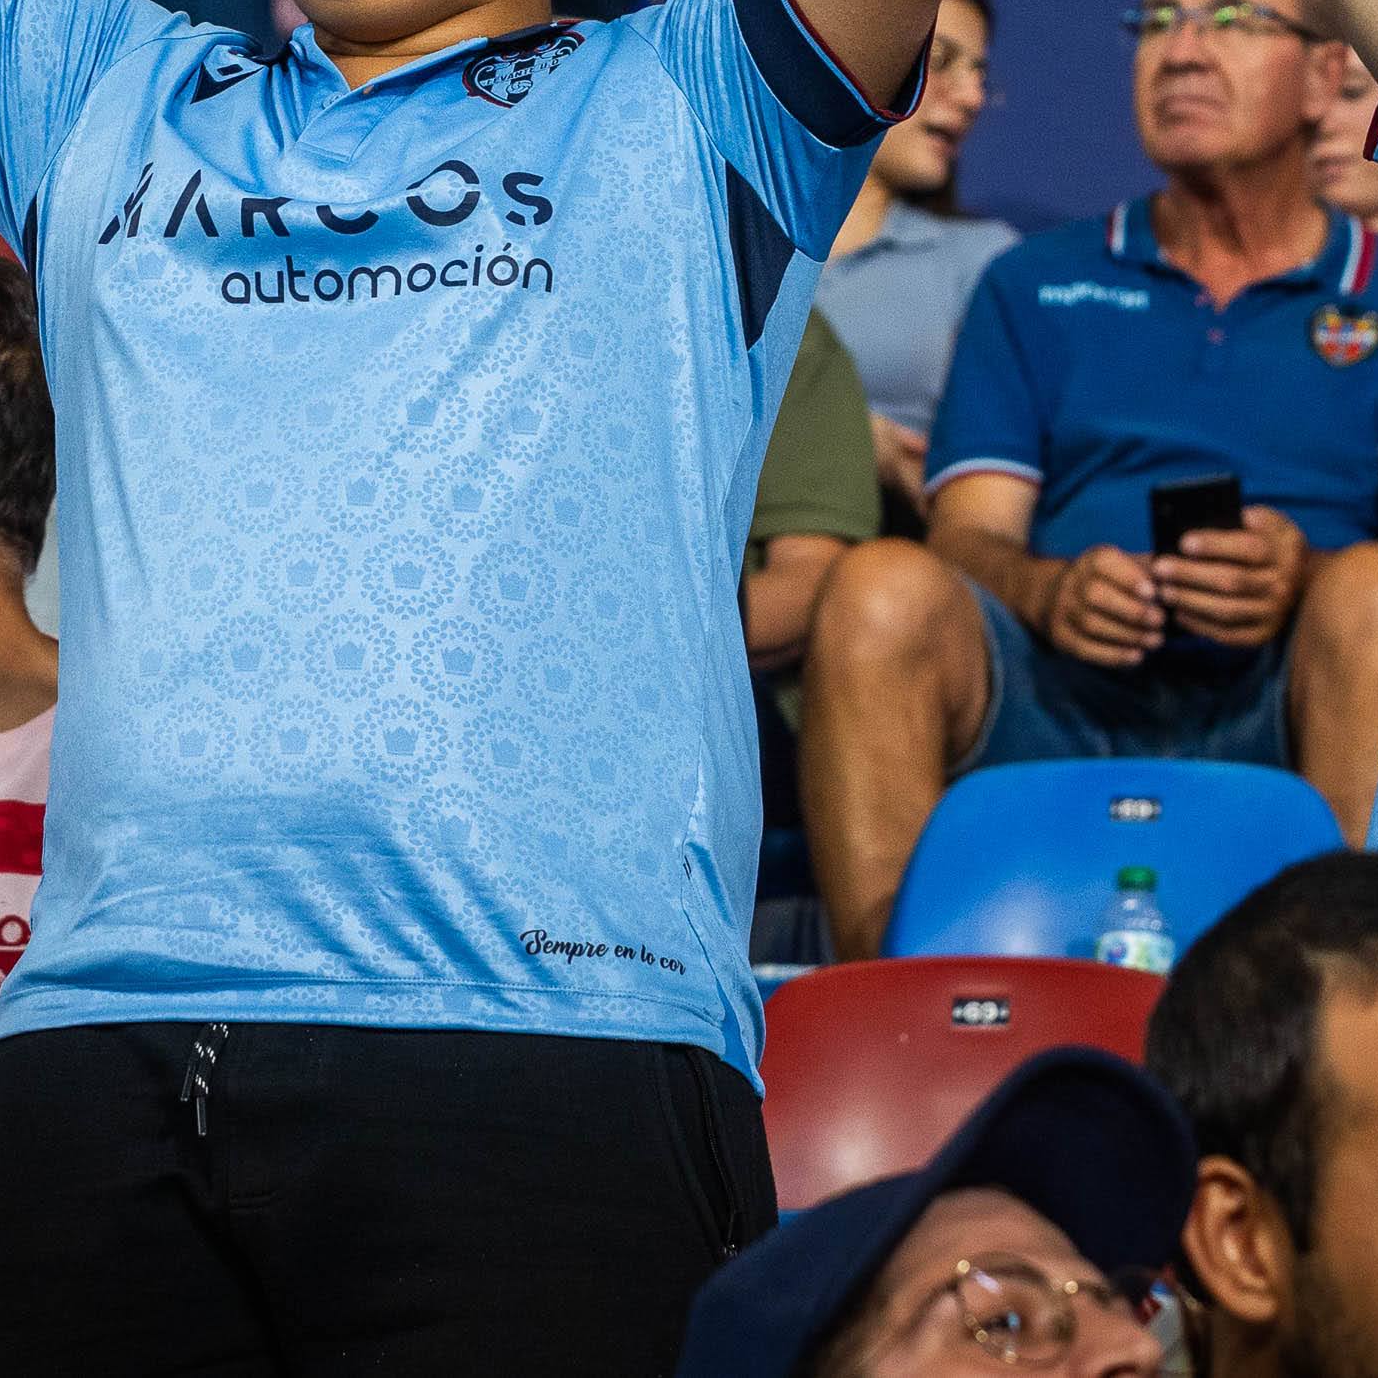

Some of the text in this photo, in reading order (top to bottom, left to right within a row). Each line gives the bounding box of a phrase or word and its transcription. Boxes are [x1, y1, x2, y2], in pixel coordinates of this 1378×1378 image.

[221, 242, 553, 305] automoción
[520, 929, 609, 964] Sempre
[614, 944, 637, 960] en
